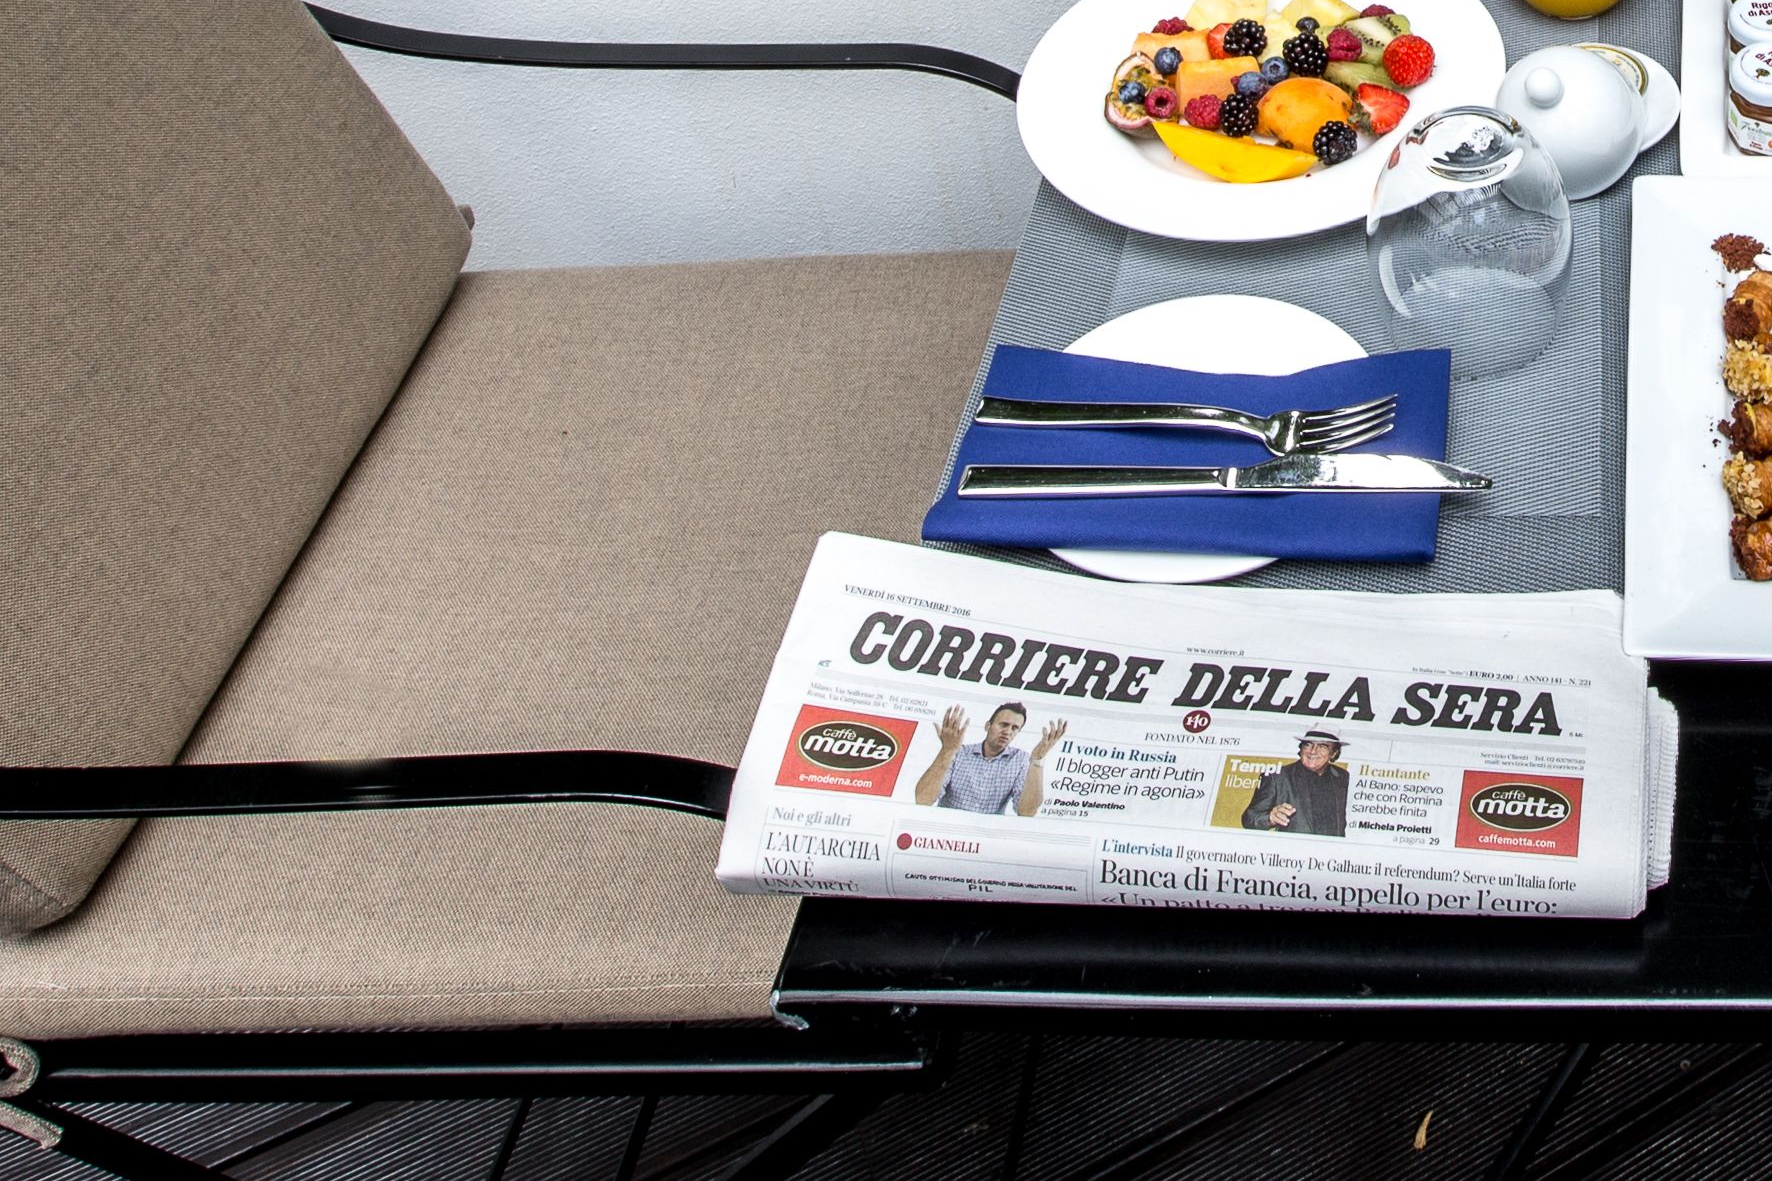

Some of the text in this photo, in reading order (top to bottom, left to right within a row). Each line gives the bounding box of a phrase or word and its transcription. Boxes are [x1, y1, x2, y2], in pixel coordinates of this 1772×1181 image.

[844, 584, 971, 617] VENERDÌ 16 SETTEMBRE 2016
[849, 610, 1165, 706] CORRIERE
[1171, 662, 1376, 722] DELLA
[1390, 681, 1562, 737] SERA
[1186, 713, 1209, 729] 140
[822, 726, 857, 740] caffè
[1144, 731, 1240, 747] FONDATO NEL 1876
[803, 734, 892, 760] motta
[1061, 740, 1177, 764] Il voto in Russia
[1055, 757, 1205, 782] Il blogger anti Putin
[1230, 759, 1282, 776] Tempi
[1359, 764, 1430, 781] Il cantante
[799, 773, 873, 788] e-moderna.com
[1050, 776, 1205, 801] «Regime in agonia»
[1224, 773, 1262, 790] liberi
[1355, 779, 1367, 789] Al
[1403, 784, 1444, 797] sapevo
[1354, 791, 1443, 807] che con Romina
[1492, 789, 1526, 801] caffè
[1053, 798, 1080, 808] Paolo
[1081, 800, 1125, 810] Valentino
[1351, 803, 1427, 818] sarebbe finita
[1477, 796, 1566, 819] motta
[773, 807, 852, 827] Noi e gli altri
[1348, 820, 1432, 835] di Michela Proietti
[914, 836, 980, 854] GIANNELLI
[1478, 833, 1556, 849] caffemotta.com
[762, 856, 814, 878] NON È
[1176, 845, 1185, 858] Il
[1186, 847, 1257, 865] governatore
[1259, 852, 1306, 872] Villeroy
[1307, 857, 1325, 871] De
[1327, 859, 1372, 876] Galhau:
[1374, 863, 1383, 877] il
[1384, 864, 1460, 883] referendum?
[1462, 871, 1496, 886] Serve
[1548, 877, 1577, 892] forte
[764, 877, 859, 892] UNA VIRTÙ
[968, 884, 993, 893] PIL
[1100, 858, 1176, 889] Banca
[1183, 866, 1208, 892] di
[1215, 869, 1318, 902] Francia,
[1325, 882, 1421, 909] appello
[1426, 891, 1471, 912] per
